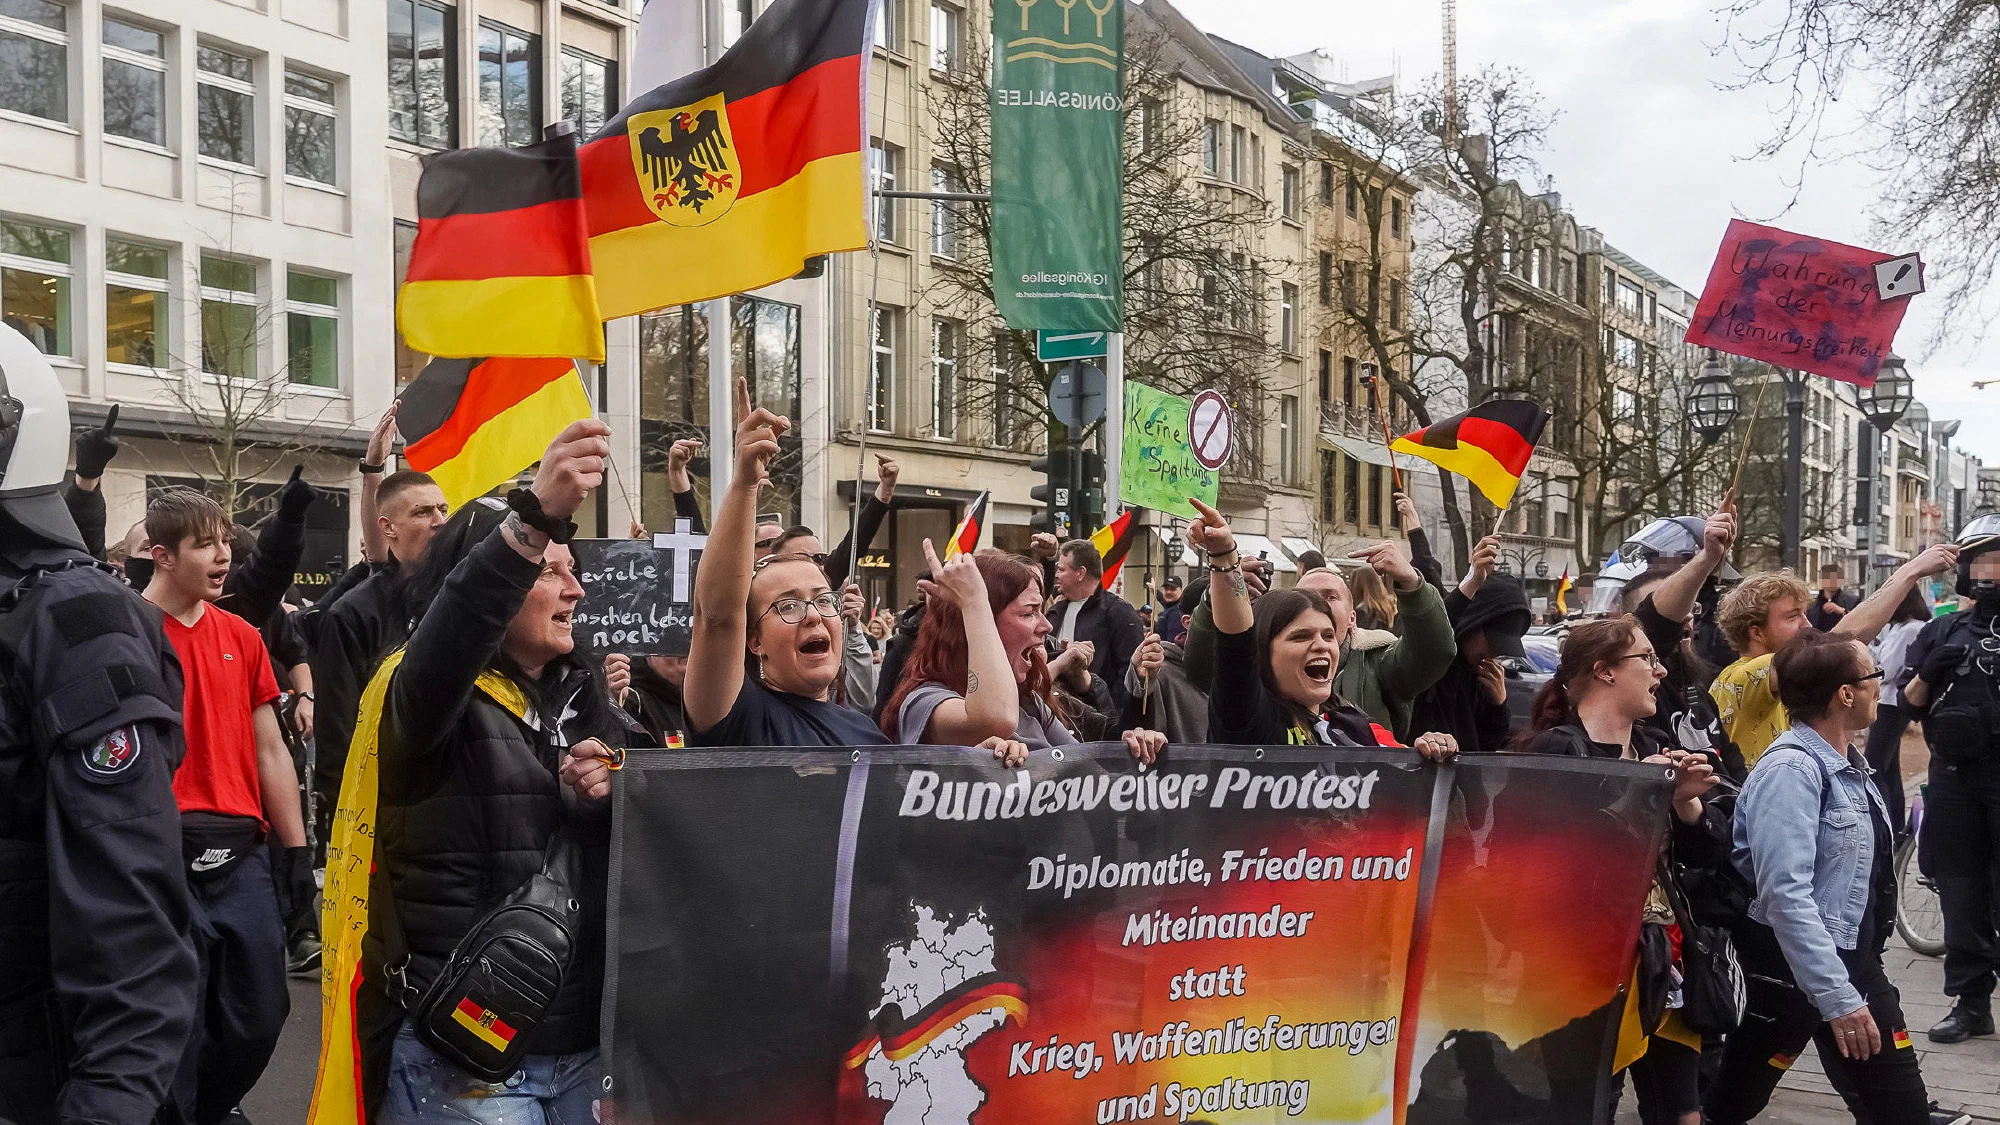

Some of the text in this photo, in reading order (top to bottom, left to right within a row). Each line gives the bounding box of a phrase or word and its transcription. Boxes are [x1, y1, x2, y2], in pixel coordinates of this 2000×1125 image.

[1731, 241, 1876, 305] Wahrung
[1775, 288, 1821, 313] der
[1703, 300, 1883, 359] Meinungsfreiheit
[1130, 395, 1182, 444] Keine
[1148, 446, 1208, 488] Spaltung
[293, 572, 332, 585] RADA
[581, 559, 658, 583] eviele
[570, 605, 643, 626] nschen
[899, 764, 1380, 821] Bundesweiter Protest
[200, 848, 231, 862] NIKE
[1026, 846, 1413, 899] Diplomatie, Frieden und
[1122, 906, 1314, 947] Miteinander
[1168, 963, 1246, 1001] statt
[1008, 1015, 1397, 1080] Krieg, Waffenlieferungen
[1096, 1077, 1311, 1125] und Spaltung
